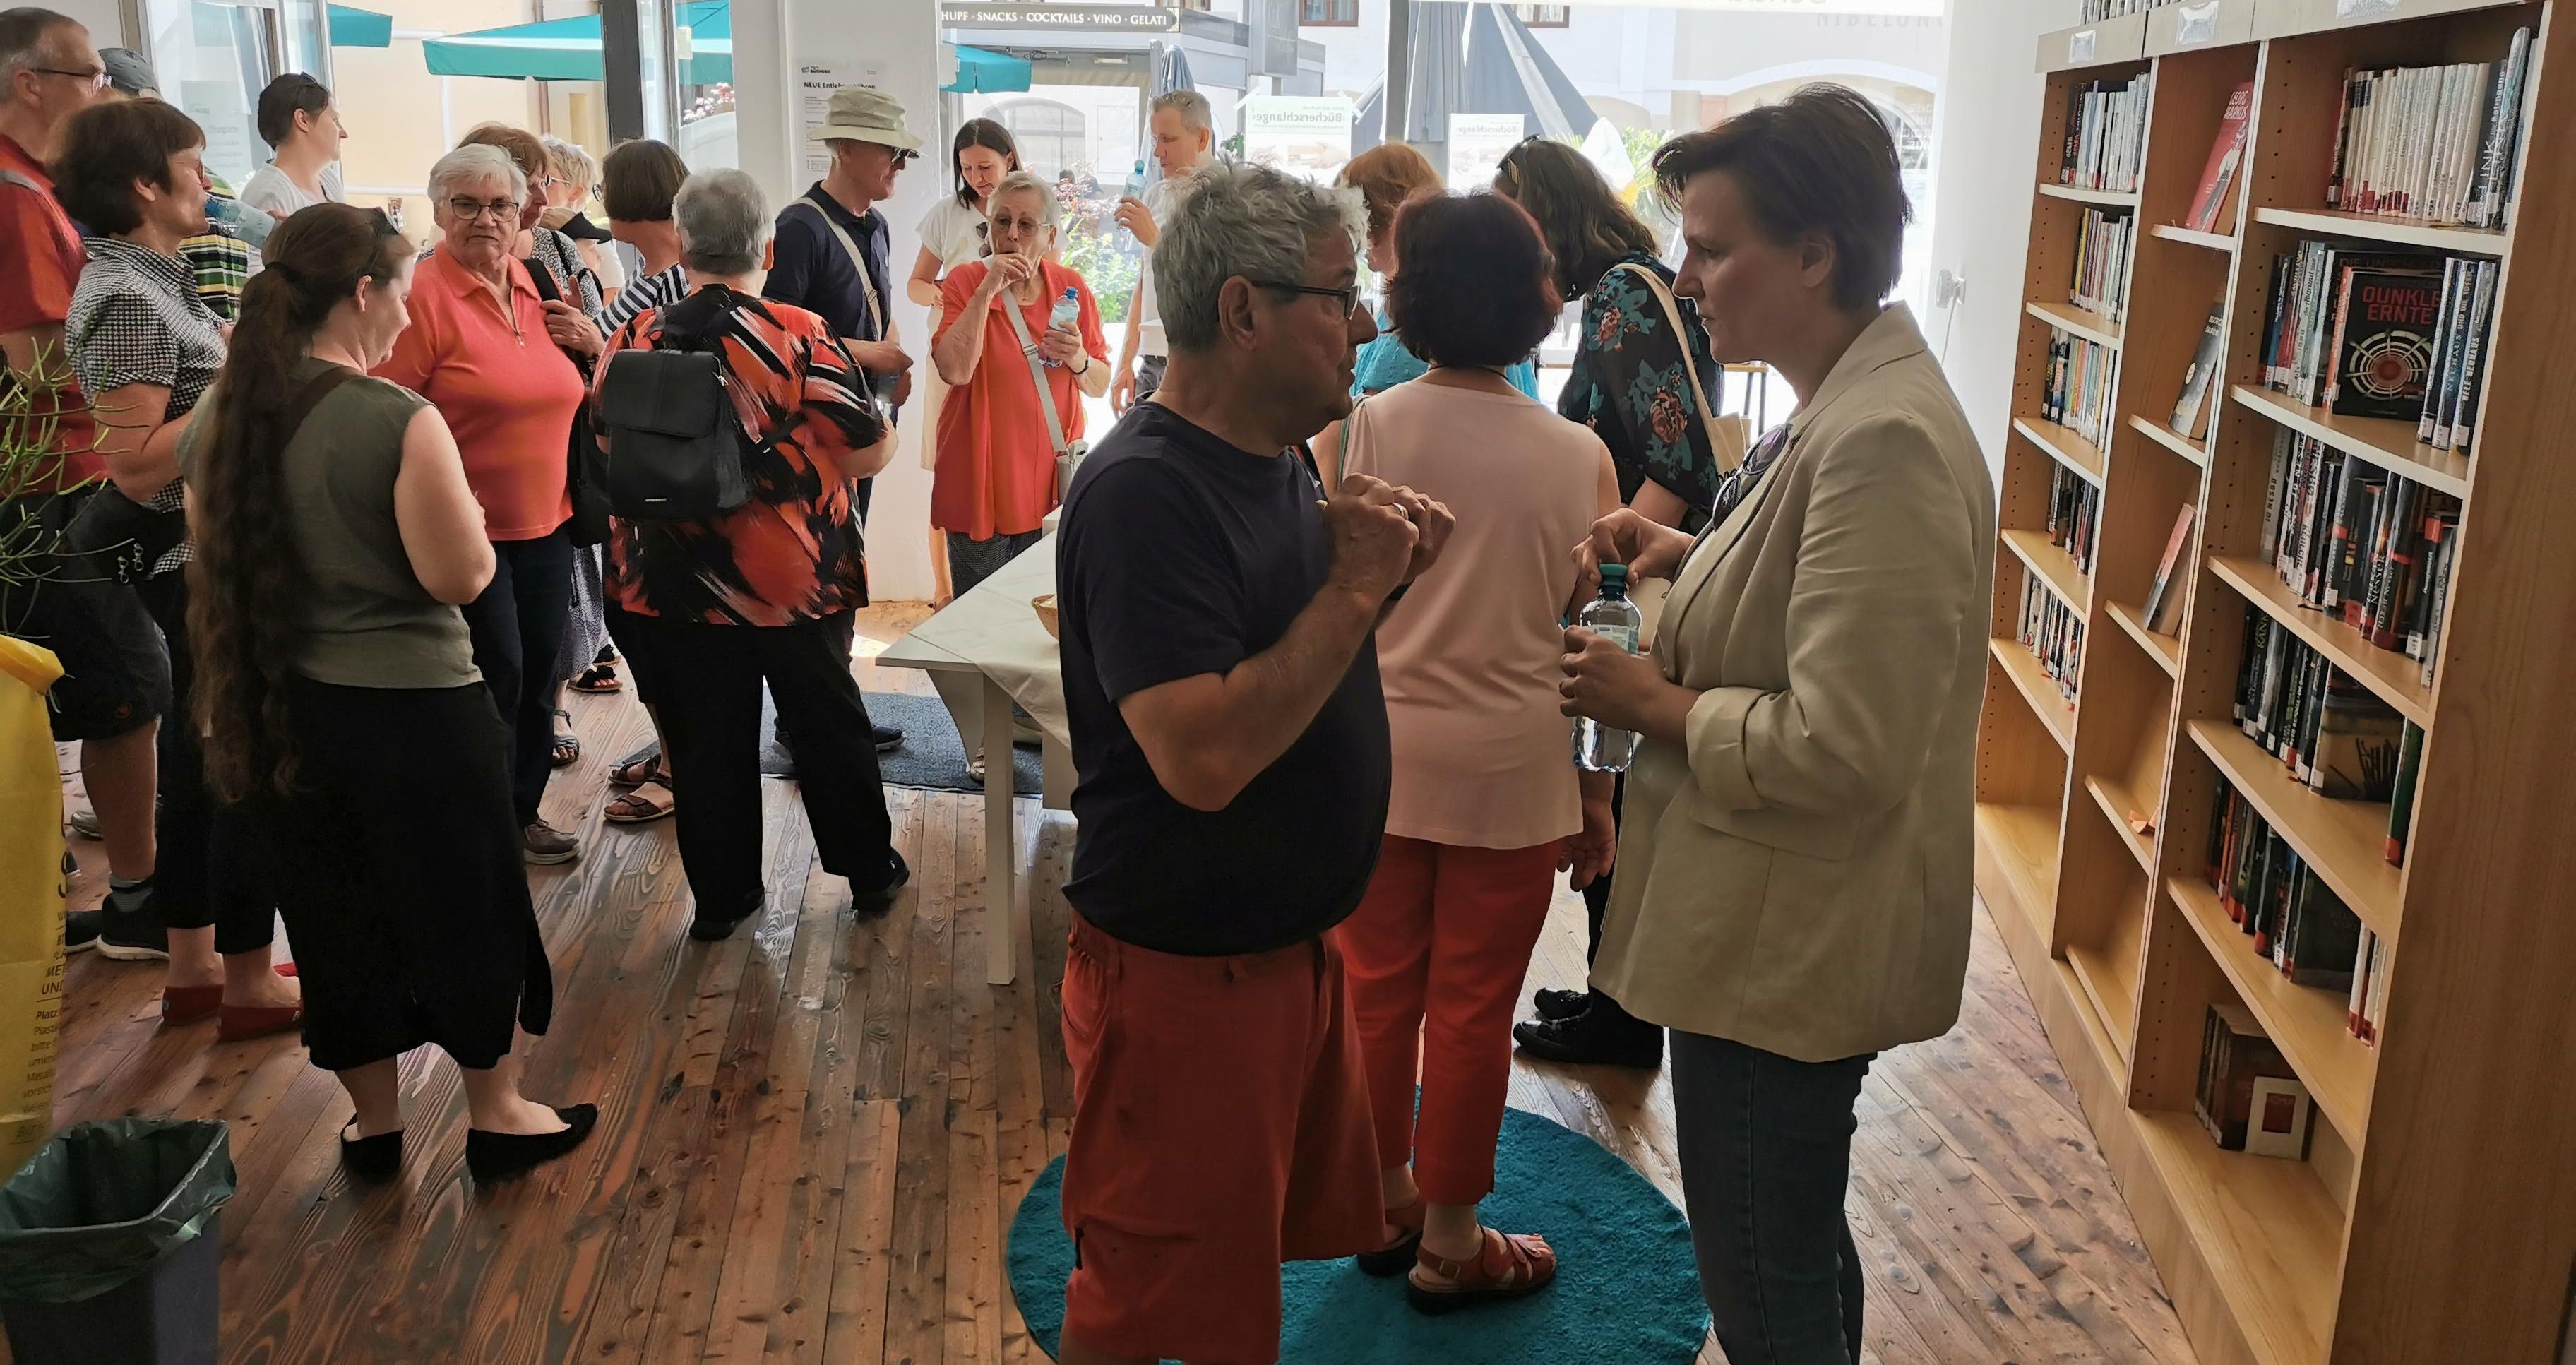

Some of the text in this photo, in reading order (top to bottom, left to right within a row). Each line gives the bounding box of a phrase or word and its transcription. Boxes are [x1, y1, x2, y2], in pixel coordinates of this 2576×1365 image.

[941, 11, 1167, 25] HUPF SNACKS COCKTAILS VINO GELATI
[2362, 286, 2440, 308] DUNKLE
[2367, 304, 2433, 325] ERNTE
